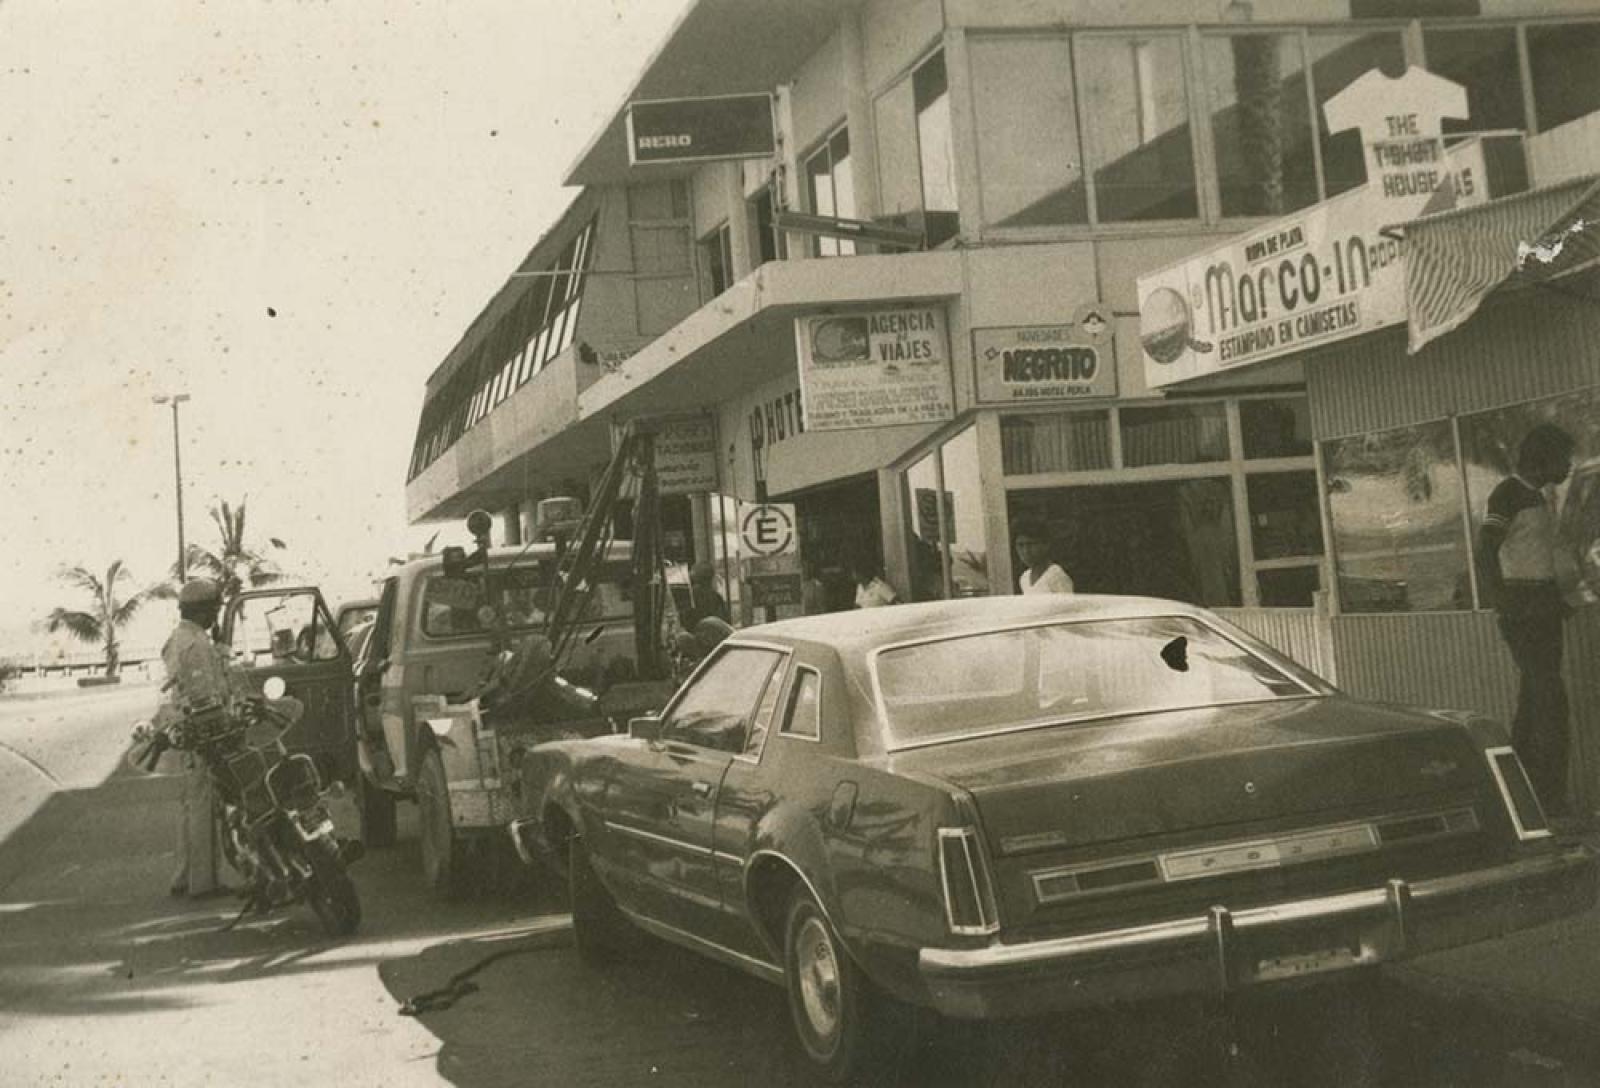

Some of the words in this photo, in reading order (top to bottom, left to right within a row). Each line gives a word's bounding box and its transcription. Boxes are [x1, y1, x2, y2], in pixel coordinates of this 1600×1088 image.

[1384, 113, 1419, 136] THE
[1383, 168, 1438, 198] HOUSE
[870, 311, 936, 335] AGENCIA
[1219, 324, 1275, 361] ESTAMPADO
[1279, 319, 1294, 345] EN
[1296, 301, 1357, 339] CAMISETAS
[879, 339, 932, 361] VIAJES
[1003, 346, 1097, 382] NEGRITO
[756, 517, 778, 545] E
